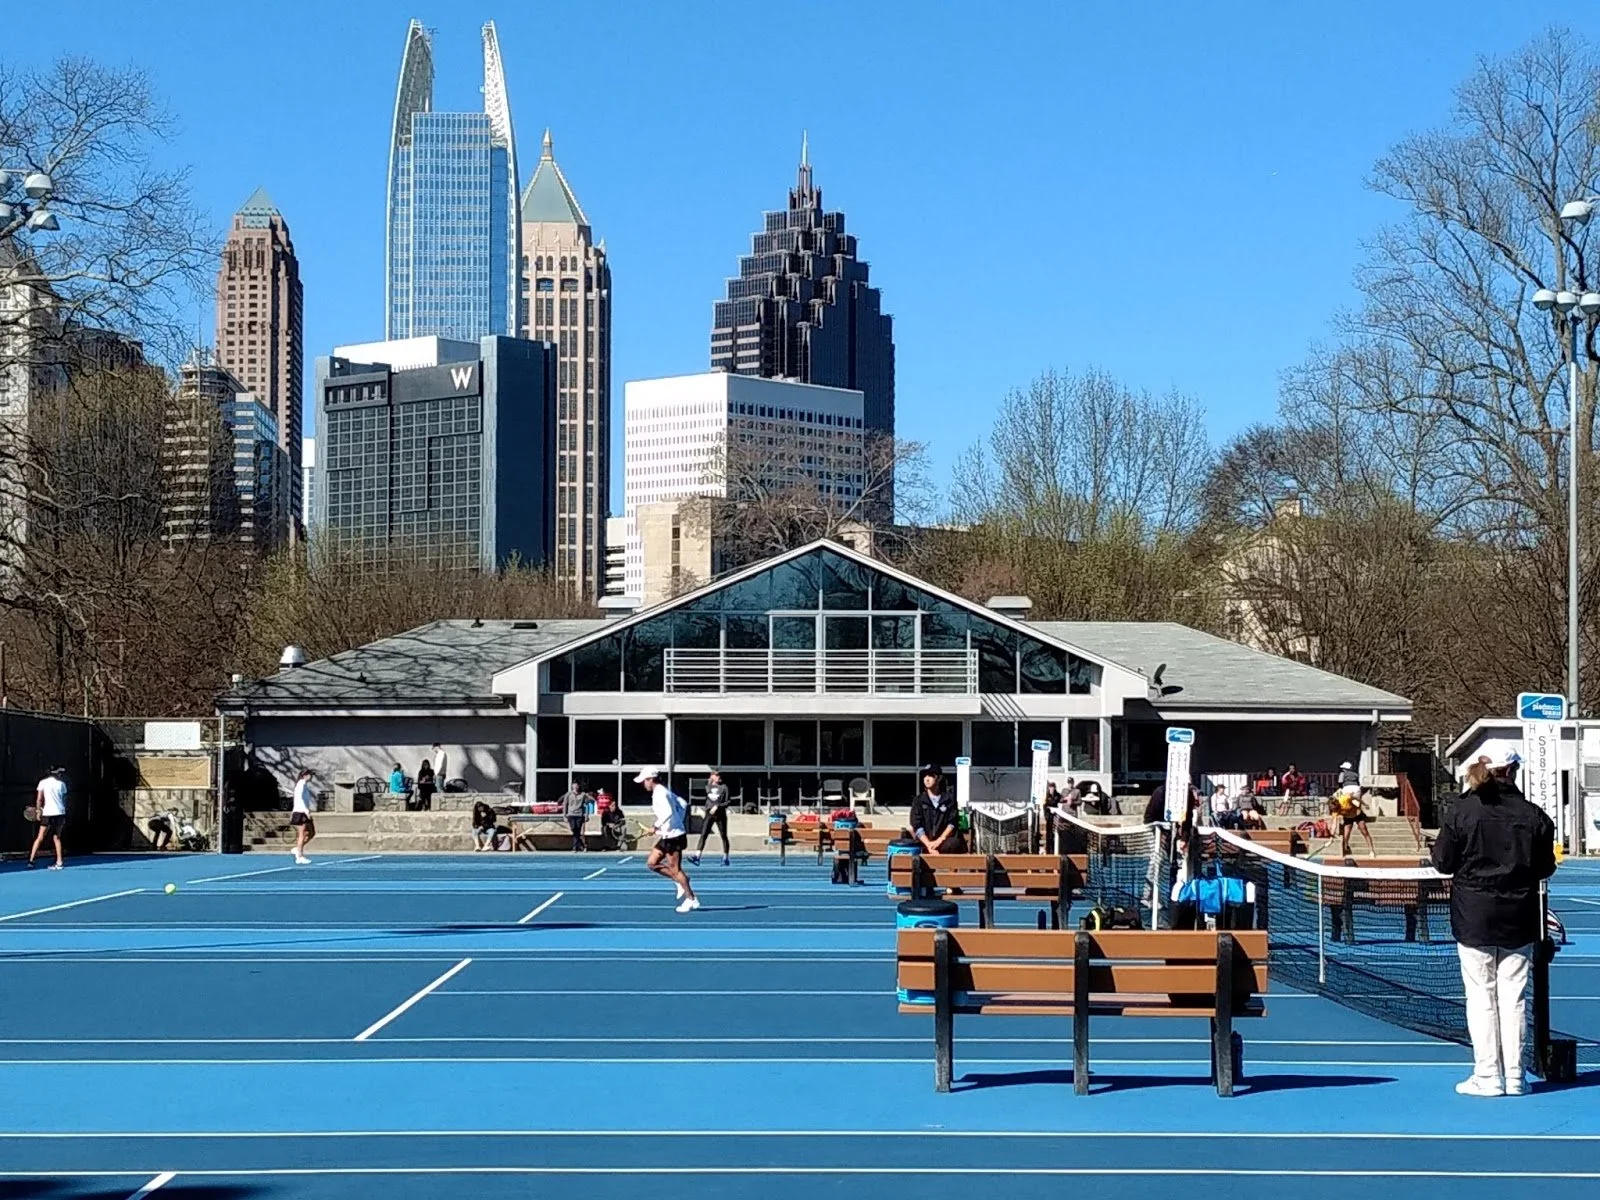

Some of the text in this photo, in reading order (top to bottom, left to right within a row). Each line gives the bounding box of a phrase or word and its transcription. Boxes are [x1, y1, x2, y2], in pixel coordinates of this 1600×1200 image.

[450, 366, 473, 391] W
[1529, 724, 1554, 733] H V
